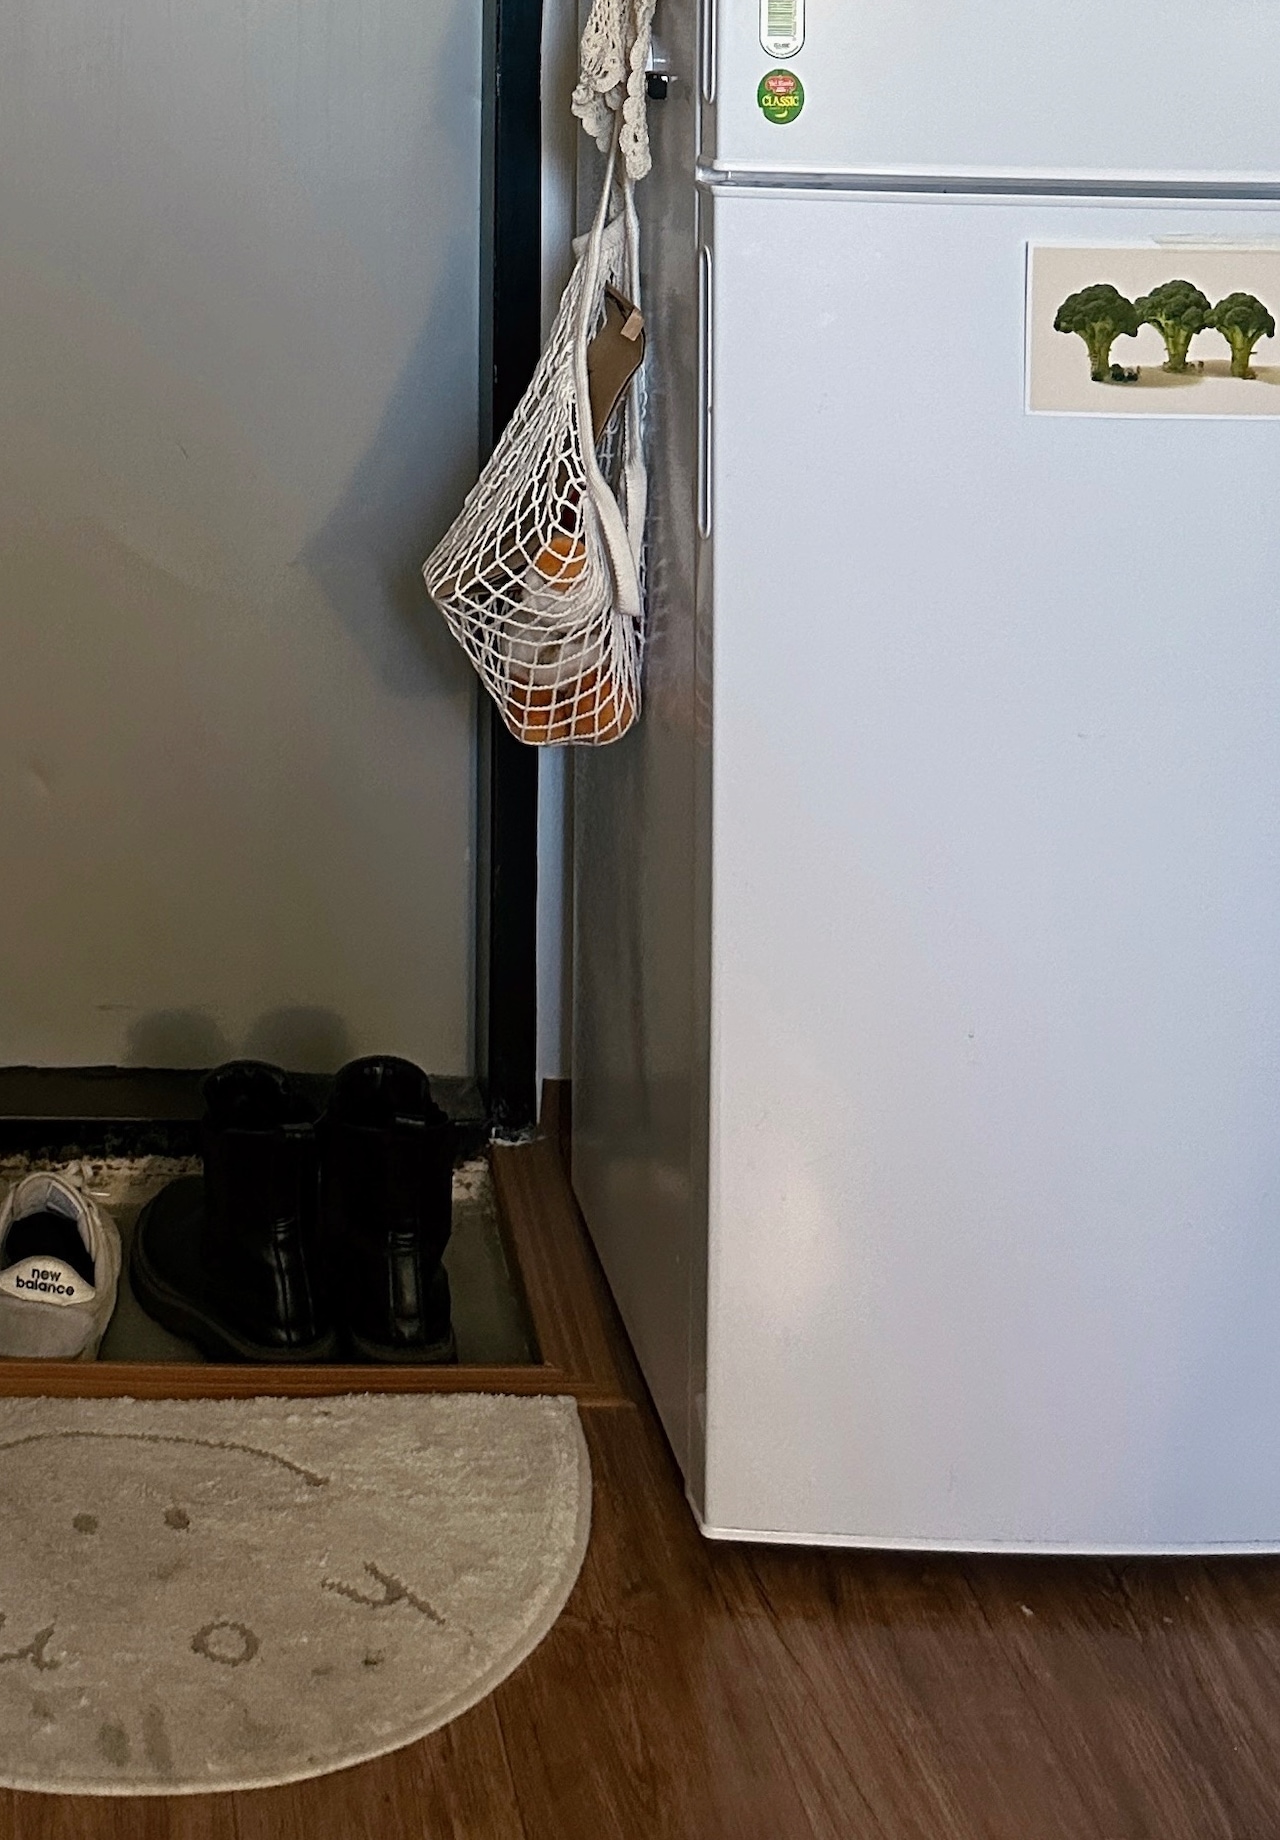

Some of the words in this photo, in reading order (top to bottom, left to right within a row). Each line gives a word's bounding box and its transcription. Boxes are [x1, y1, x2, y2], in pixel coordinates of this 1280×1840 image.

[762, 95, 800, 107] CLASSIC
[32, 1268, 61, 1281] new
[16, 1276, 75, 1296] balance
